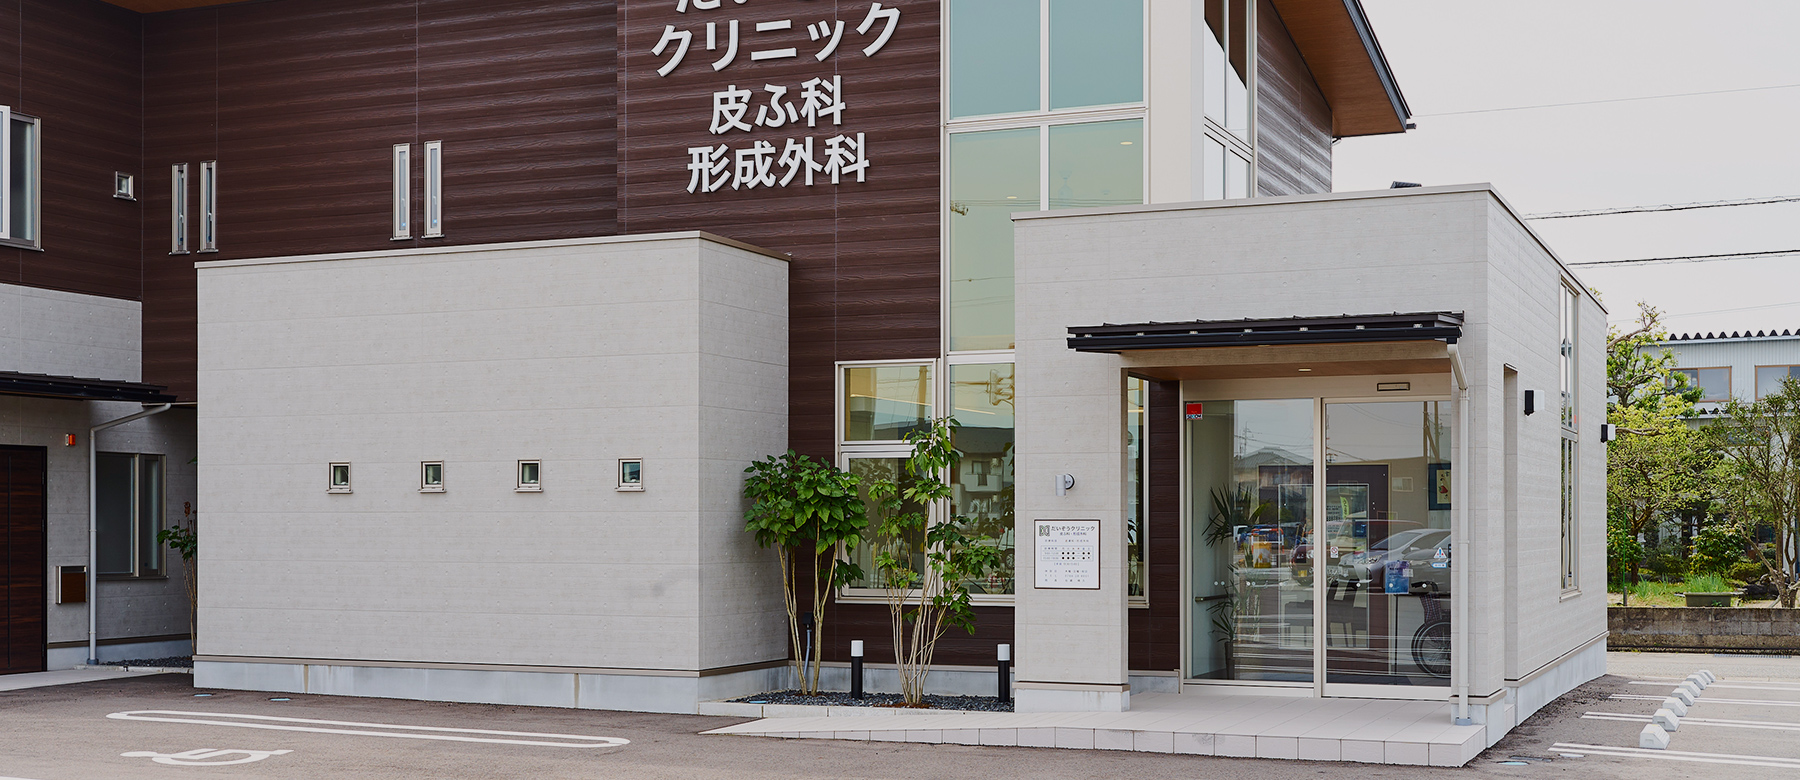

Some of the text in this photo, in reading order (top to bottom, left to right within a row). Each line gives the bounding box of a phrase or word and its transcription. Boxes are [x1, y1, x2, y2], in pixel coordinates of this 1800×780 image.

[651, 2, 901, 77] クリニック
[708, 74, 847, 135] 皮ふ科
[686, 132, 870, 194] 形成外科
